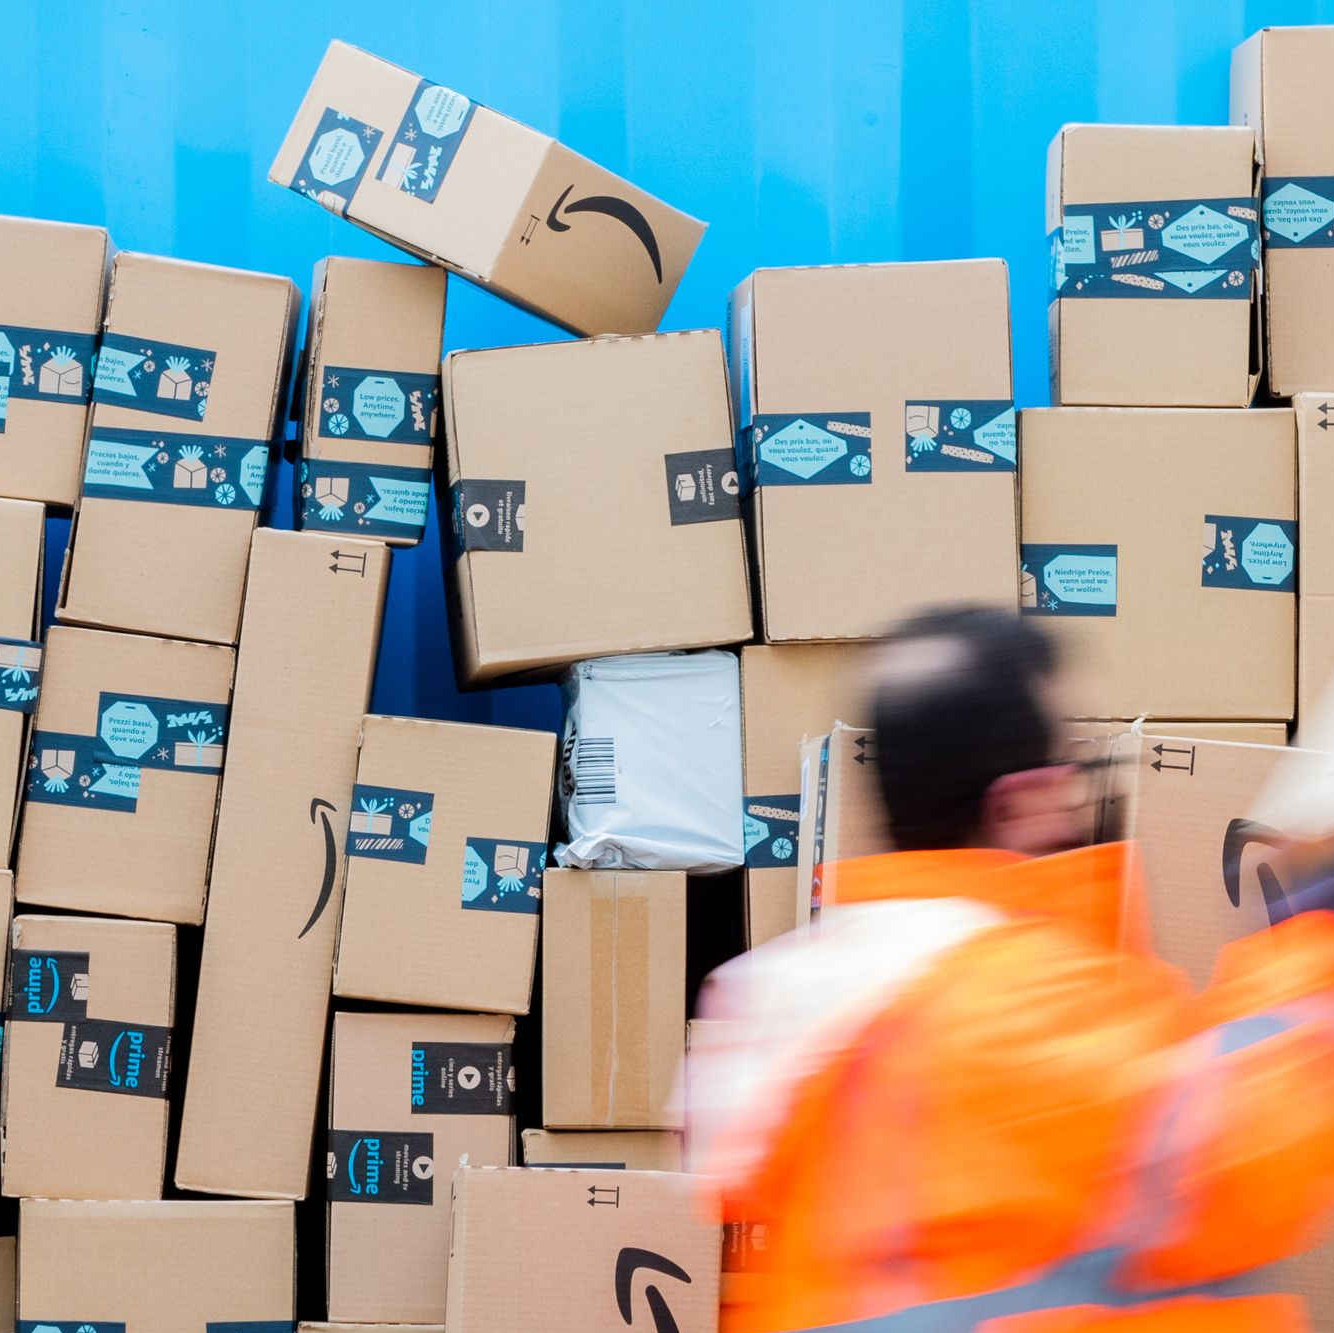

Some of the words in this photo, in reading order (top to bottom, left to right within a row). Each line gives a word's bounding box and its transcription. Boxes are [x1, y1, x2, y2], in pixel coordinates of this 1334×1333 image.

[375, 393, 400, 403] prices.
[362, 401, 395, 411] Anytime,
[359, 410, 398, 420] anywhere.
[774, 438, 788, 446] Des
[789, 437, 804, 446] prix
[805, 437, 821, 446] bas,
[821, 436, 832, 444] où
[89, 449, 117, 459] Precios
[117, 451, 139, 461] bajos,
[786, 445, 814, 454] voulez,
[814, 445, 839, 454] quand
[799, 454, 826, 462] voulez.
[96, 459, 124, 468] cuando
[124, 460, 130, 470] y
[87, 466, 111, 475] donde
[112, 469, 142, 478] quieras.
[705, 463, 713, 491] delivery
[696, 467, 707, 503] unlimited,
[497, 499, 504, 507] et
[505, 491, 513, 520] livraison
[496, 507, 504, 535] gratuite
[503, 520, 512, 543] rapide
[1248, 540, 1286, 549] anywhere.
[1250, 548, 1283, 559] Anytime,
[1246, 557, 1270, 566] prices.
[1271, 559, 1287, 567] Low
[1054, 568, 1086, 577] Niedrige
[1087, 568, 1112, 577] Preise,
[1058, 576, 1079, 584] wann
[1080, 576, 1096, 584] und
[1075, 585, 1103, 593] wollen.
[108, 716, 131, 725] Prezzi
[131, 719, 153, 728] bassi,
[111, 726, 140, 735] quando
[108, 733, 127, 742] dove
[128, 736, 146, 744] vuoi.
[22, 956, 45, 1014] prime
[124, 1030, 146, 1088] prime
[495, 1051, 503, 1081] entregas
[411, 1048, 429, 1106] prime
[487, 1071, 496, 1091] gratis
[495, 1081, 503, 1107] rápidas
[402, 1143, 410, 1168] movies
[362, 1137, 384, 1195] prime
[393, 1150, 402, 1184] streaming
[402, 1182, 408, 1191] tv
